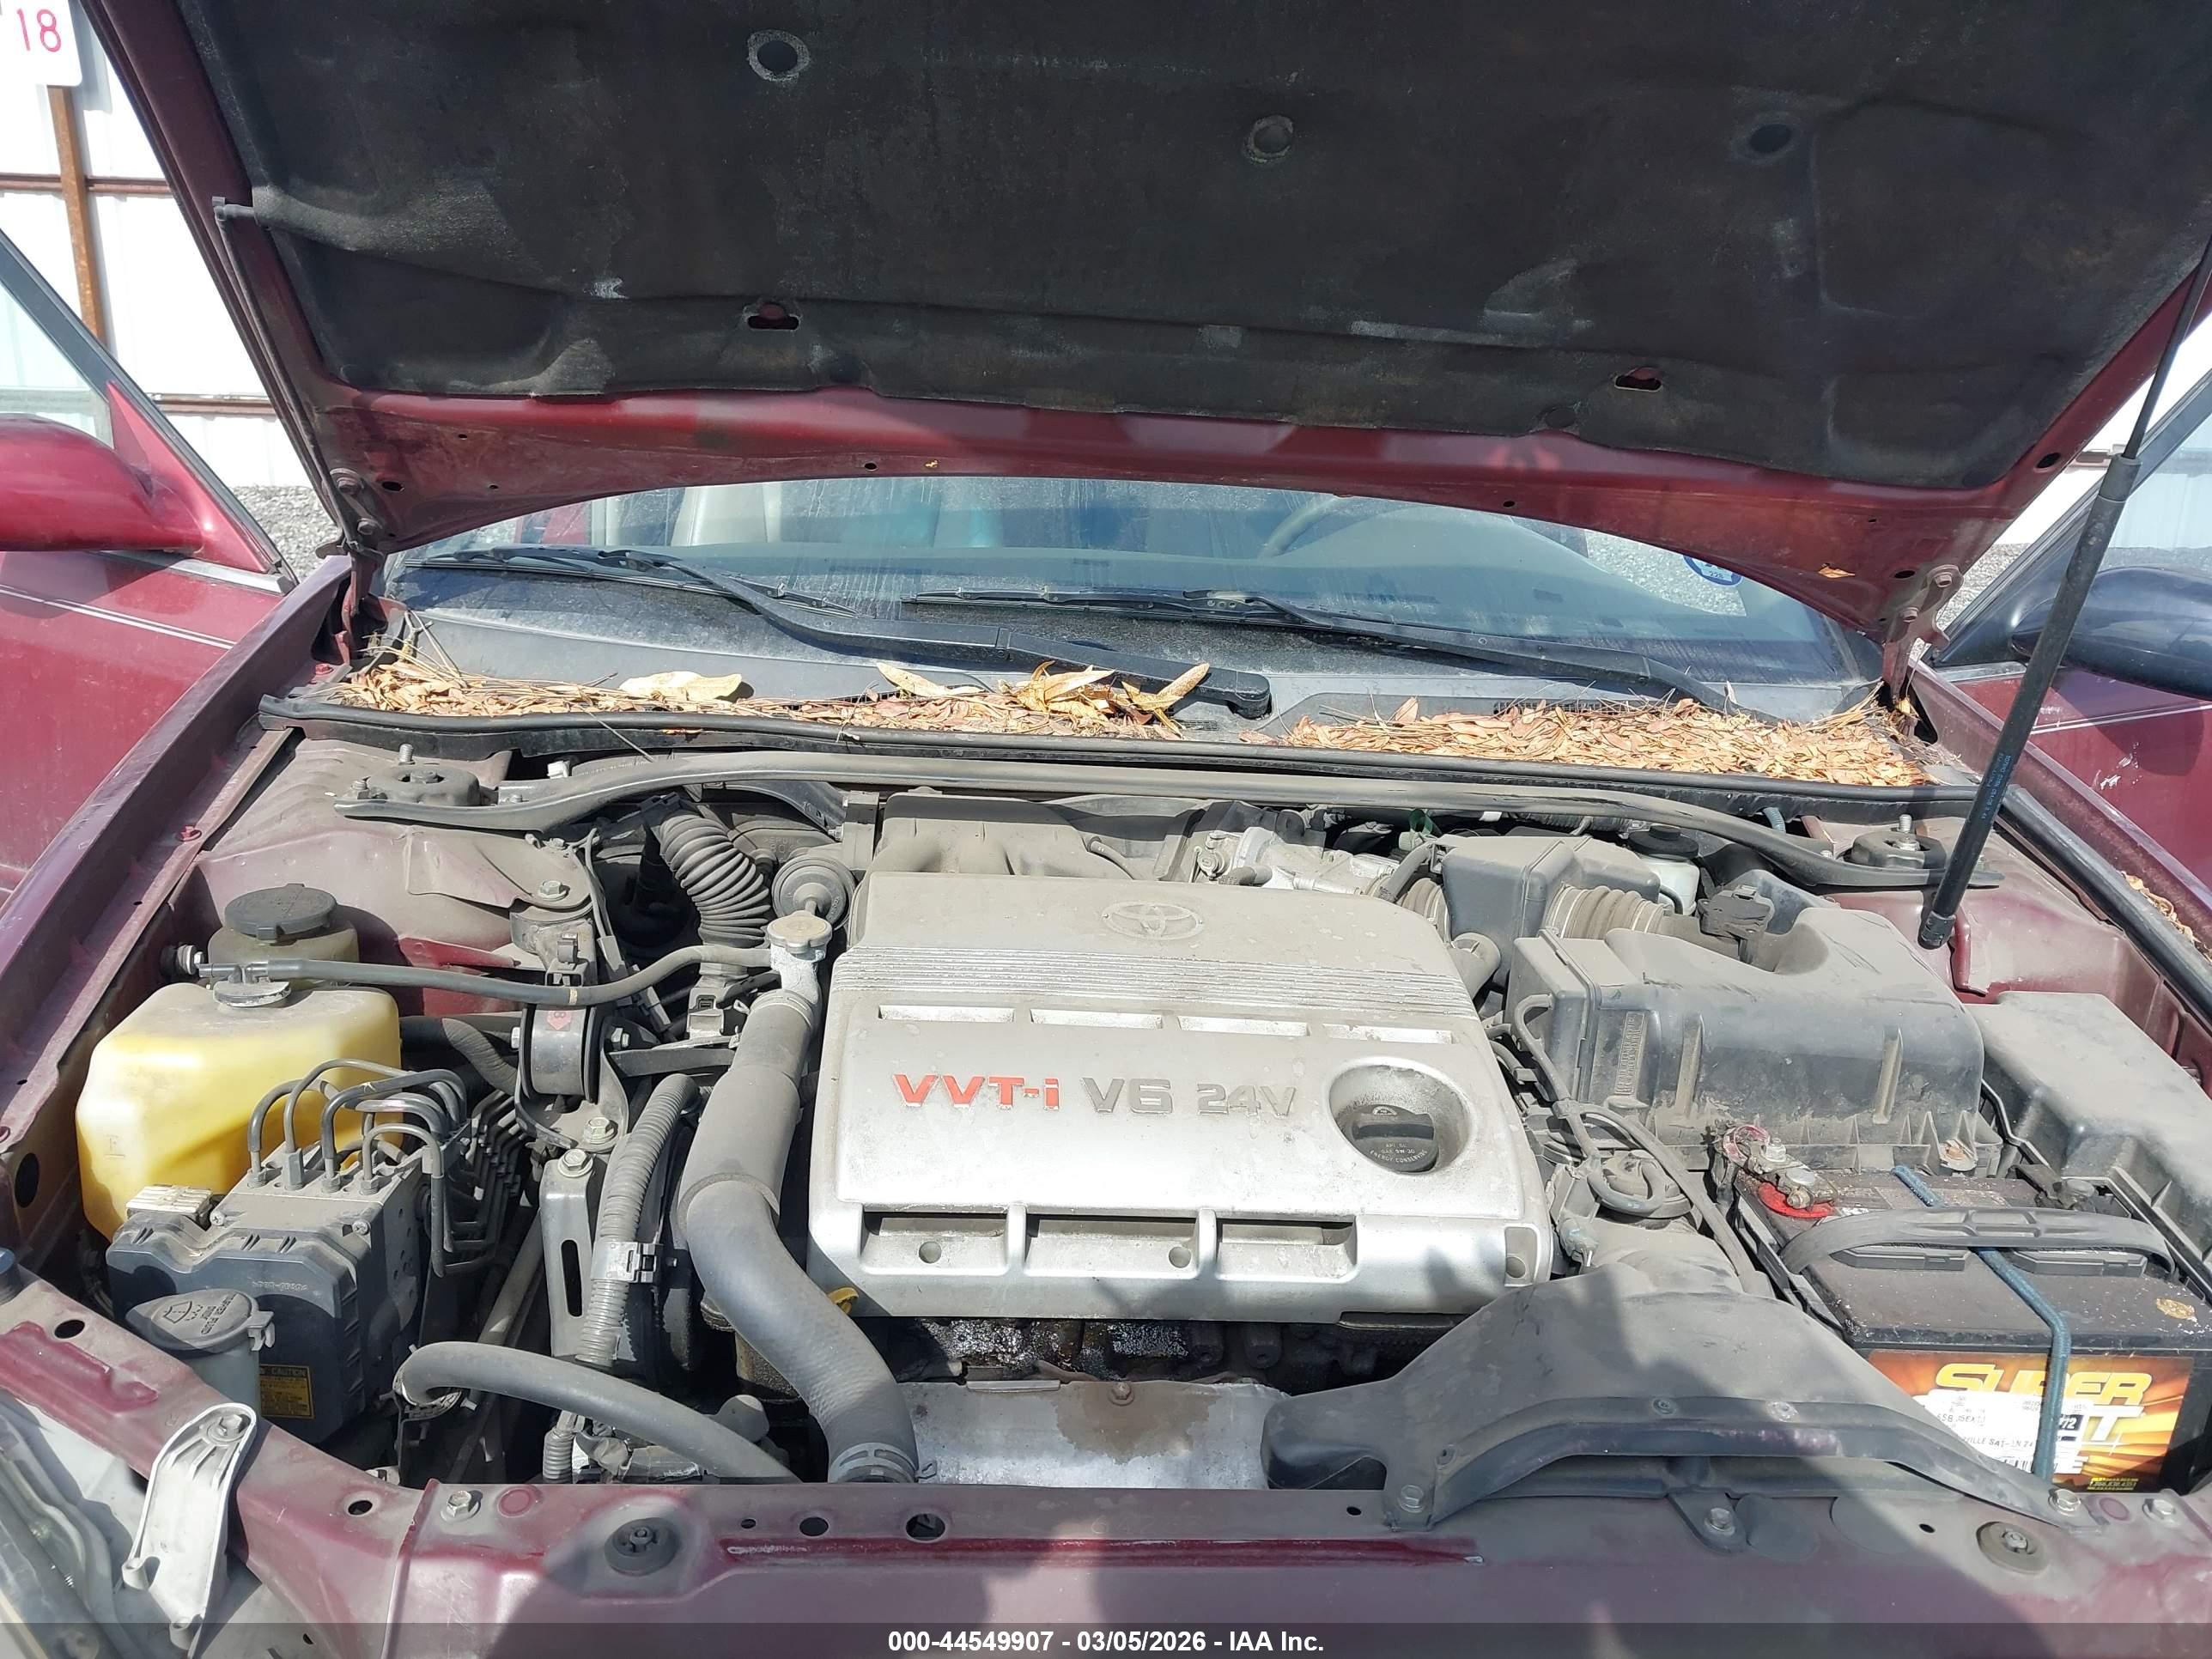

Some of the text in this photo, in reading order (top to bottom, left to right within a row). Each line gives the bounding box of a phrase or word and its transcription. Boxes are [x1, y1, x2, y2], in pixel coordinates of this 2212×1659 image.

[16, 8, 61, 52] 18
[893, 1073, 1297, 1116] VVT-i V6 24V
